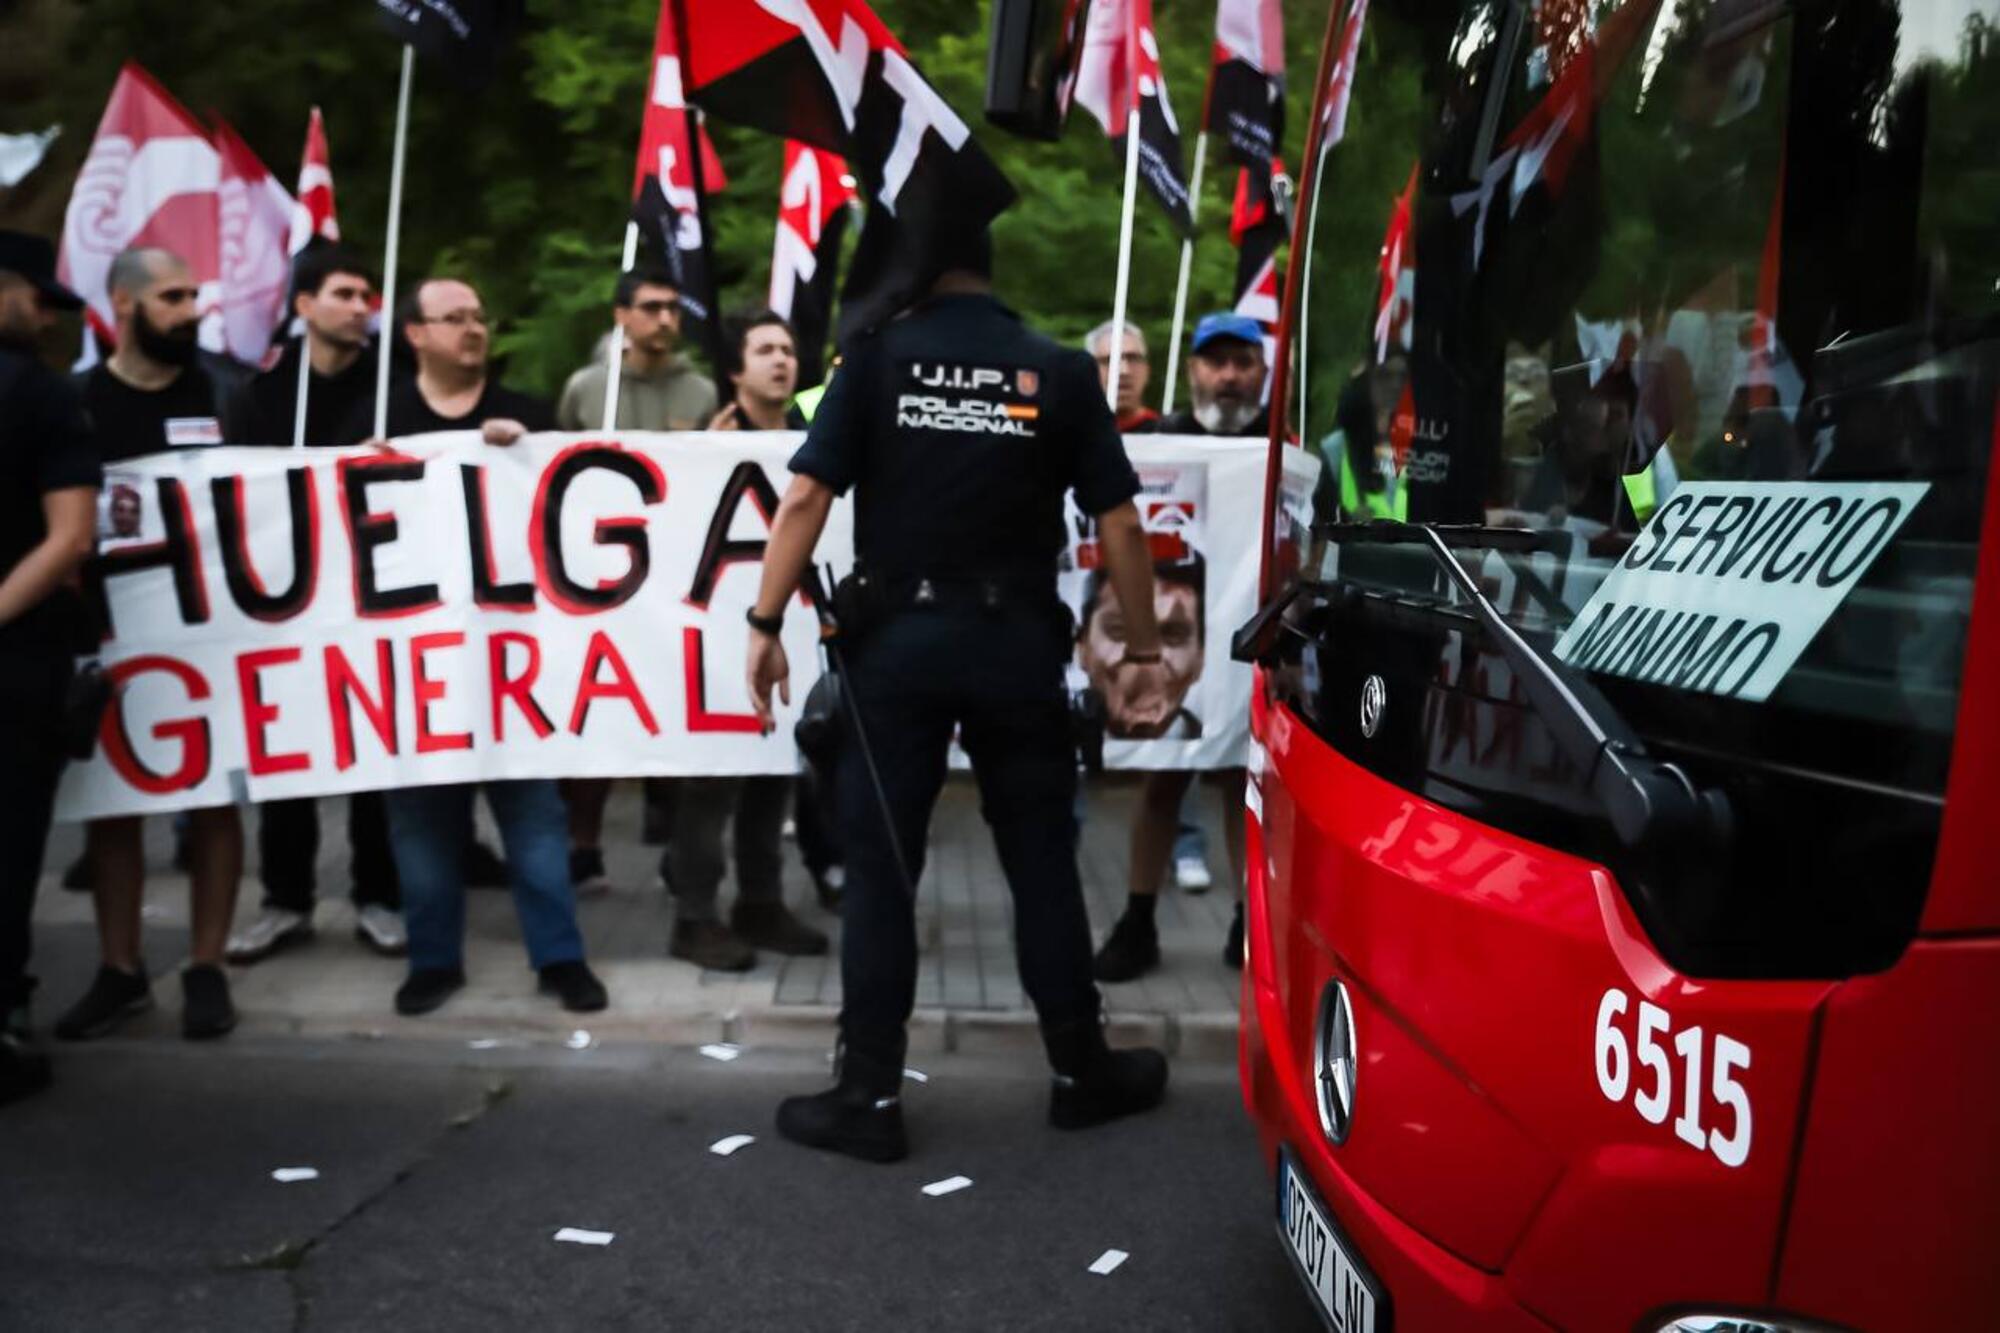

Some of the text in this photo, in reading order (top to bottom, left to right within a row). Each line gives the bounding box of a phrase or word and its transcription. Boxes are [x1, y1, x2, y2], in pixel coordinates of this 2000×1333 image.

[898, 411, 1036, 437] NACIONAL
[899, 394, 1010, 417] POLICIA
[98, 441, 815, 642] HUELGA
[1624, 493, 1902, 588] SERVICIO
[1564, 602, 1782, 697] MINIMO
[98, 626, 775, 795] GENERAL
[1595, 988, 1752, 1167] 6515
[1288, 1175, 1326, 1288] 0707
